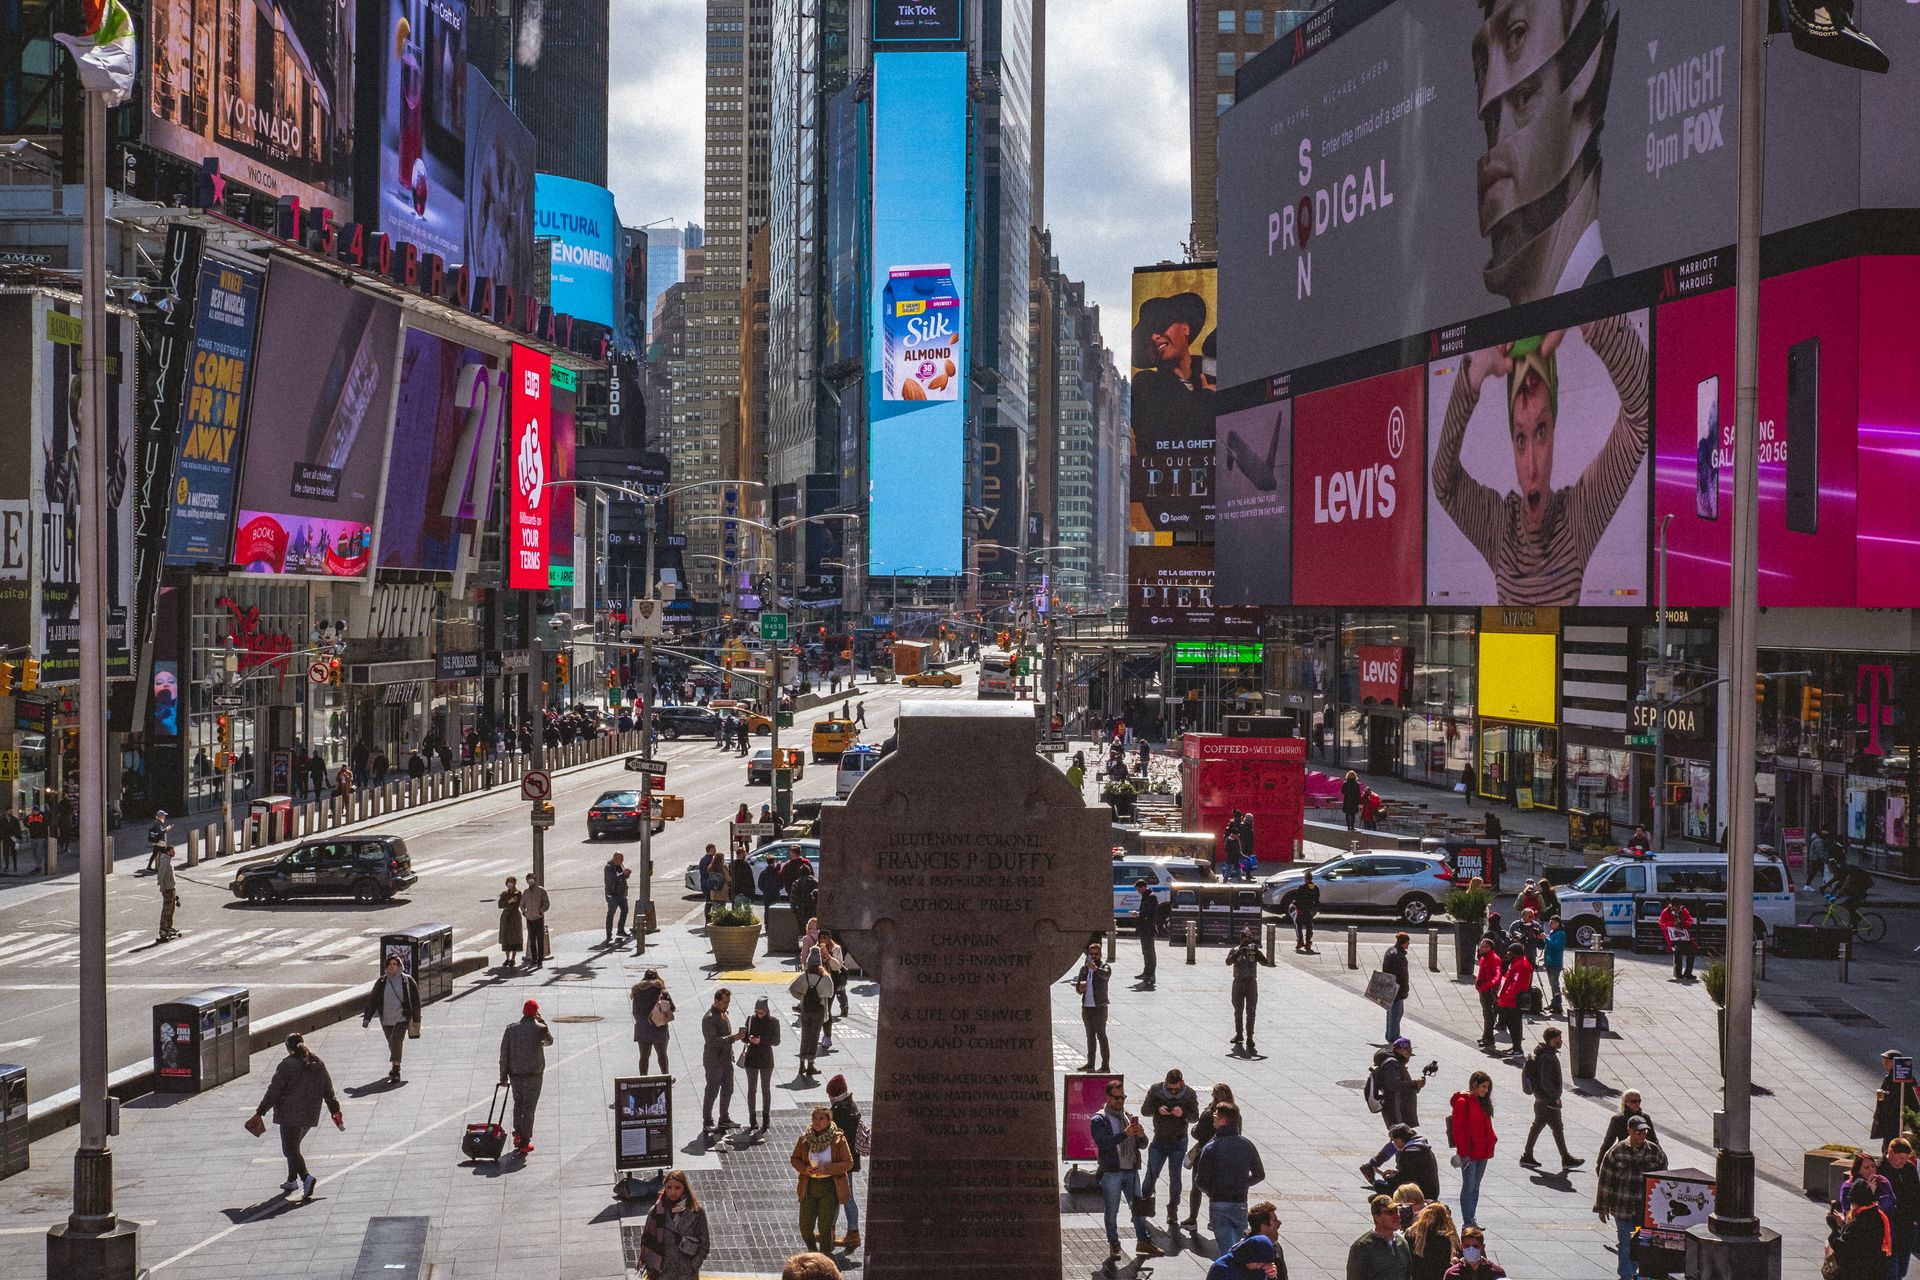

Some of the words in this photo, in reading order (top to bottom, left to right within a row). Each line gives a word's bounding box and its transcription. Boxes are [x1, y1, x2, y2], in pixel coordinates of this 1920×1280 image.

[898, 5, 937, 16] TikTok
[1306, 7, 1334, 33] MARRIOTT
[1306, 26, 1331, 50] MARQUIS
[1323, 78, 1357, 104] MICHAEL
[1361, 58, 1389, 84] SHEEN
[1647, 45, 1725, 125] TONIGHT
[223, 90, 301, 151] VORNADO
[1321, 135, 1341, 158] Enter
[1341, 128, 1353, 148] the
[1354, 118, 1373, 143] mind
[1375, 109, 1384, 129] of
[1384, 112, 1390, 125] a
[1391, 97, 1413, 121] serial
[236, 130, 263, 151] REALTY
[266, 145, 289, 162] TRUST
[1646, 131, 1678, 179] 9pm
[1683, 104, 1724, 160] FOX
[247, 165, 278, 191] VNO.COM
[1268, 159, 1394, 257] PRODIGAL
[1680, 256, 1718, 276] MARRIOTT
[1680, 273, 1713, 292] MARQUIS
[210, 288, 224, 310] BEST
[225, 293, 246, 317] MUSICAL
[402, 242, 575, 350] BROADWAY
[903, 312, 953, 348] Silk
[1441, 326, 1467, 340] MARRIOTT
[197, 338, 212, 350] COME
[214, 341, 239, 356] TOGETHER
[1441, 339, 1464, 352] MARQUIS
[904, 347, 951, 362] ALMOND
[194, 351, 244, 394] COME
[923, 364, 932, 372] 30
[1273, 374, 1291, 385] MARRIOTT
[609, 364, 620, 416] 1500
[1273, 386, 1289, 396] MARQUIS
[188, 386, 240, 429] FROM
[1723, 420, 1775, 446] SANG
[183, 422, 236, 464] AWAY
[1156, 441, 1170, 450] DE
[1172, 440, 1185, 449] LA
[1773, 441, 1787, 462] 5G
[1142, 457, 1154, 468] EL
[1166, 456, 1191, 466] QUE
[303, 467, 311, 479] Give
[317, 471, 331, 482] children
[1146, 468, 1208, 497] PIE
[302, 484, 316, 495] chance
[321, 485, 335, 497] believe.
[519, 511, 536, 525] Billboards
[1170, 514, 1190, 523] Spotify
[1230, 511, 1239, 519] MOST
[1240, 509, 1257, 518] COUNTRIES
[1029, 516, 1037, 534] FX
[252, 526, 275, 541] BOOKS
[522, 527, 539, 548] YOUR
[520, 550, 540, 570] TERMS
[820, 575, 834, 584] FX
[1141, 586, 1214, 608] PIER
[367, 584, 437, 638] FOREVER
[1655, 611, 1689, 622] SPHORA
[452, 656, 464, 669] POLO
[384, 684, 413, 704] FOREVER
[1632, 736, 1638, 744] W
[1640, 736, 1648, 744] 46
[1204, 744, 1249, 754] COFFEED
[1253, 745, 1272, 754] SWEET
[1274, 745, 1302, 754] CHURROS
[2, 752, 10, 777] ATM
[649, 764, 662, 772] WAY
[889, 833, 971, 847] LIEUTENANT
[975, 833, 1043, 847] COLONEL
[876, 851, 960, 870] FRANCIS
[988, 852, 1056, 870] DUFFY
[1457, 855, 1482, 867] ERIKA
[1457, 867, 1482, 878] JAYNE
[887, 875, 914, 887] MAY
[917, 876, 925, 887] 2
[899, 898, 973, 912] CATHOLIC
[980, 898, 1033, 912] PRIEST
[931, 934, 1000, 947] CHAPLAIN
[917, 973, 945, 984] OLD
[950, 973, 981, 984] 69TH
[901, 1008, 911, 1021] A
[917, 1008, 946, 1021] LIFE
[950, 1008, 968, 1021] OF
[975, 1008, 1033, 1022] SERVICE
[952, 1024, 977, 1034] FOR
[894, 1037, 928, 1049] GOD
[931, 1038, 963, 1049] AND
[968, 1038, 1036, 1050] COUNTRY
[1011, 1074, 1039, 1085] WAR
[876, 1090, 905, 1102] NEW
[908, 1091, 939, 1102] YORK
[944, 1091, 1006, 1102] NATIONAL
[1010, 1091, 1054, 1102] GUARD
[921, 1123, 969, 1135] WORLD
